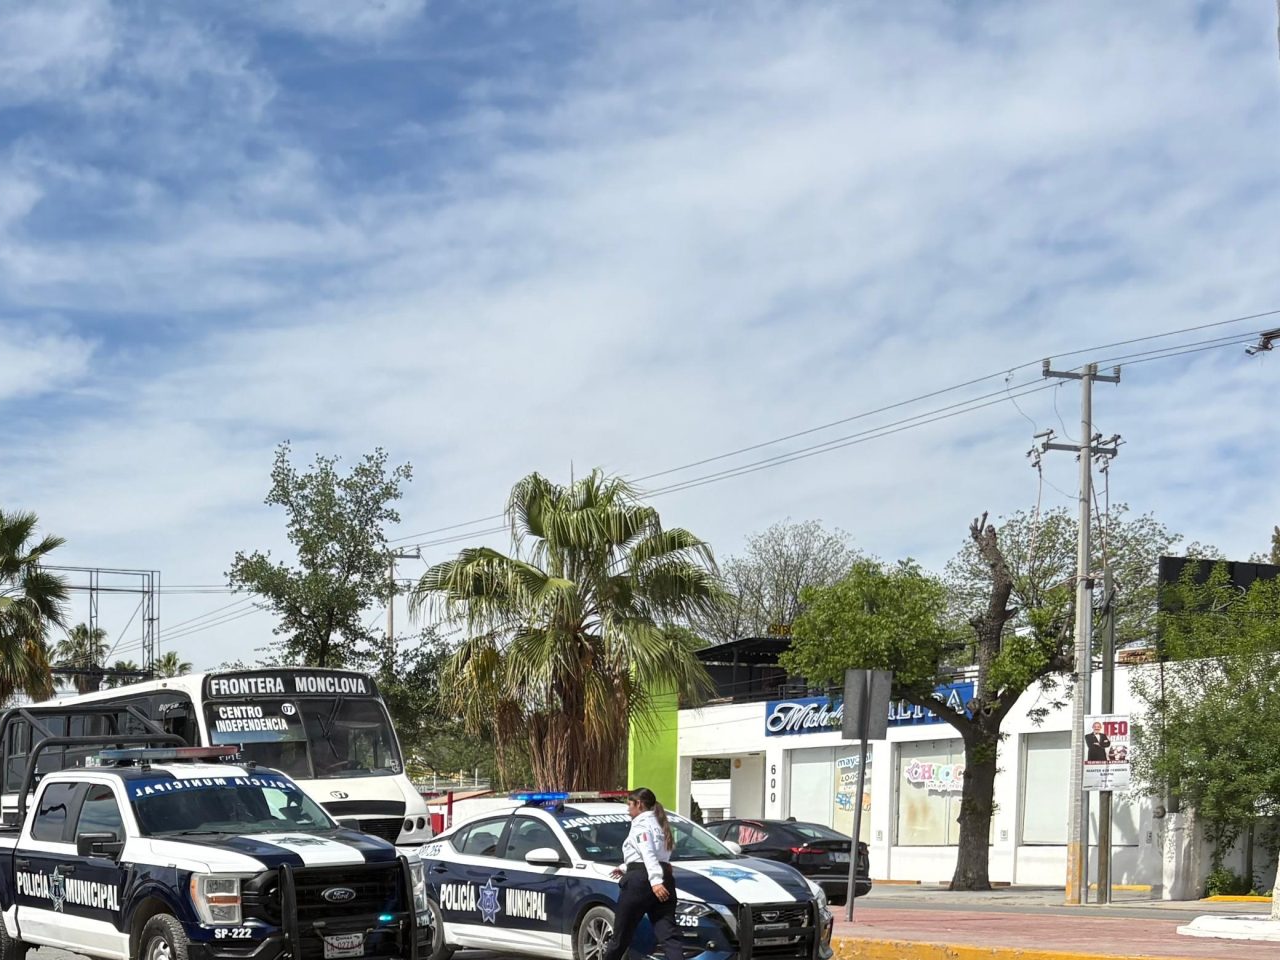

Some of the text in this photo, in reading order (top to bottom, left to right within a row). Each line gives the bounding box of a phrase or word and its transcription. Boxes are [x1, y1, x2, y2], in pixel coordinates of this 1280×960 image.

[211, 676, 366, 695] FRONTERA MONCLOVA
[219, 705, 263, 719] CENTRO
[283, 704, 294, 714] 07
[216, 718, 289, 733] INDEPENDENCIA
[16, 870, 120, 912] POLICÍA MUNICIPAL
[440, 881, 547, 921] POLICÍA MUNICIPAL
[675, 915, 699, 927] -255
[214, 928, 252, 939] SP-222
